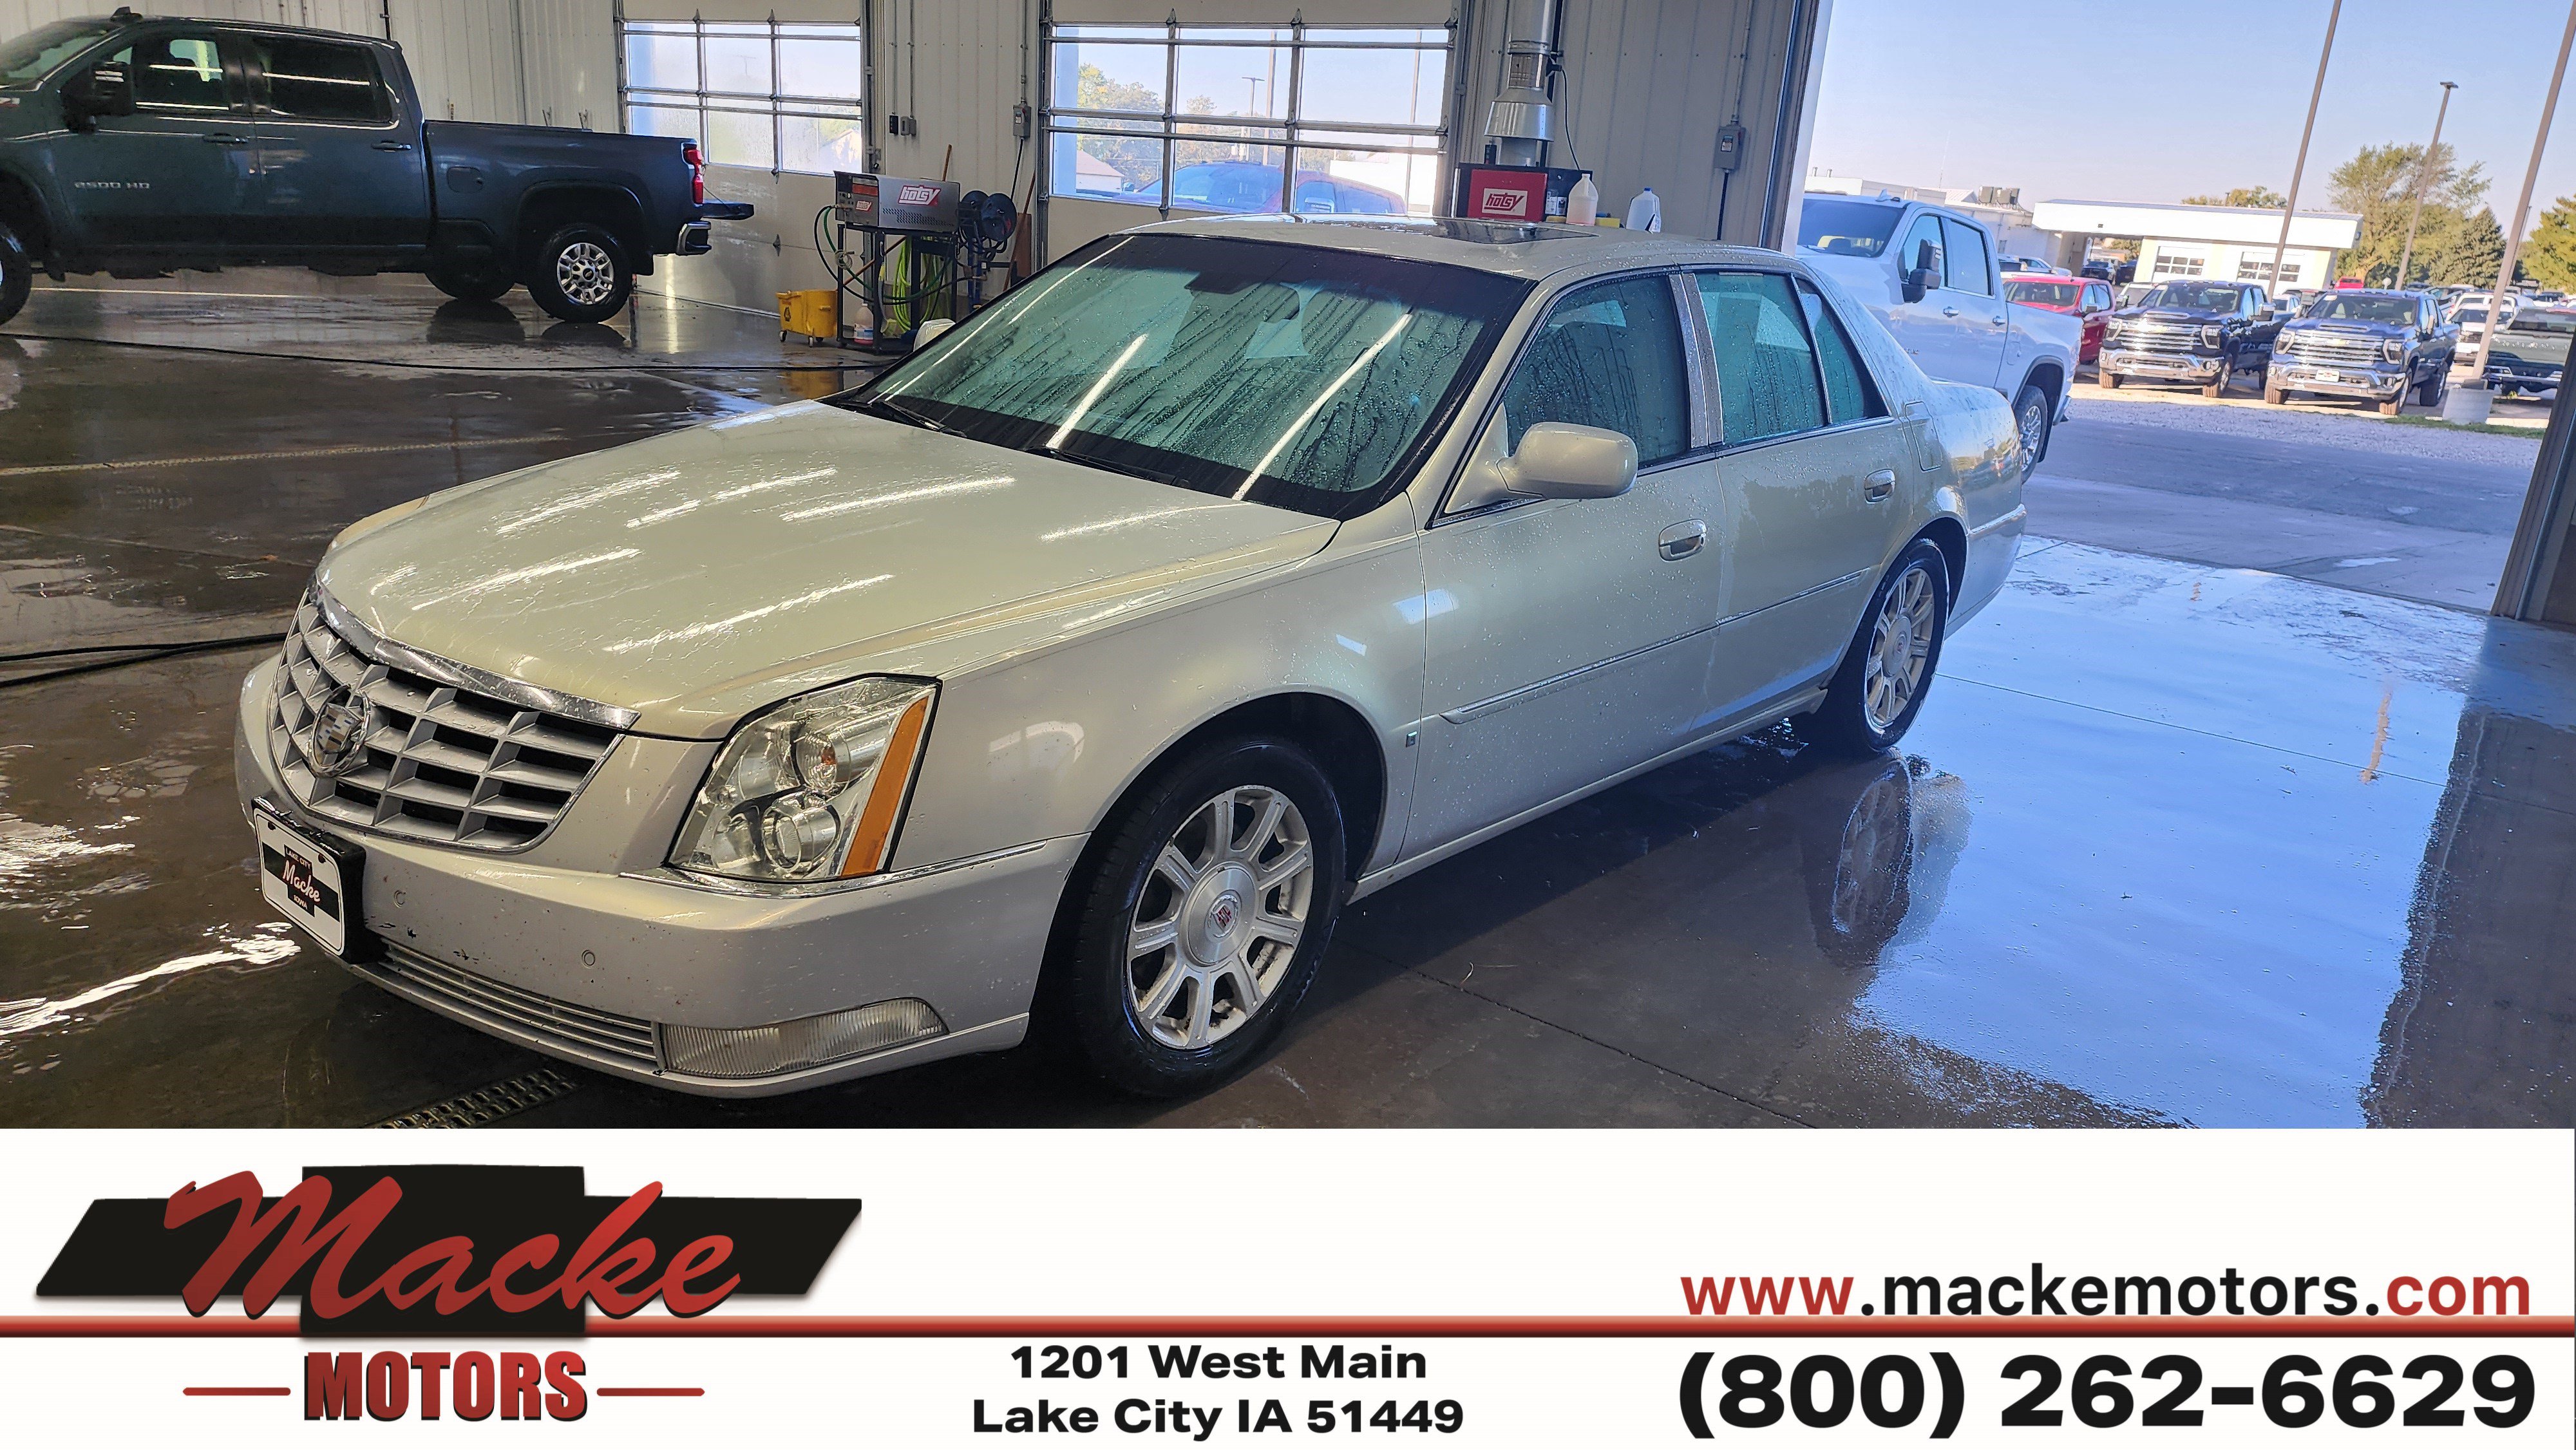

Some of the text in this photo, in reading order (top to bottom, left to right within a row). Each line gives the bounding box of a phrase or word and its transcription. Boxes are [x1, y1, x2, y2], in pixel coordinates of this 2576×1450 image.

[898, 185, 942, 205] hotsy
[1484, 192, 1524, 211] hotsy
[285, 847, 312, 869] LAKE CITY
[282, 860, 321, 903] Macke
[293, 894, 308, 910] IOWA
